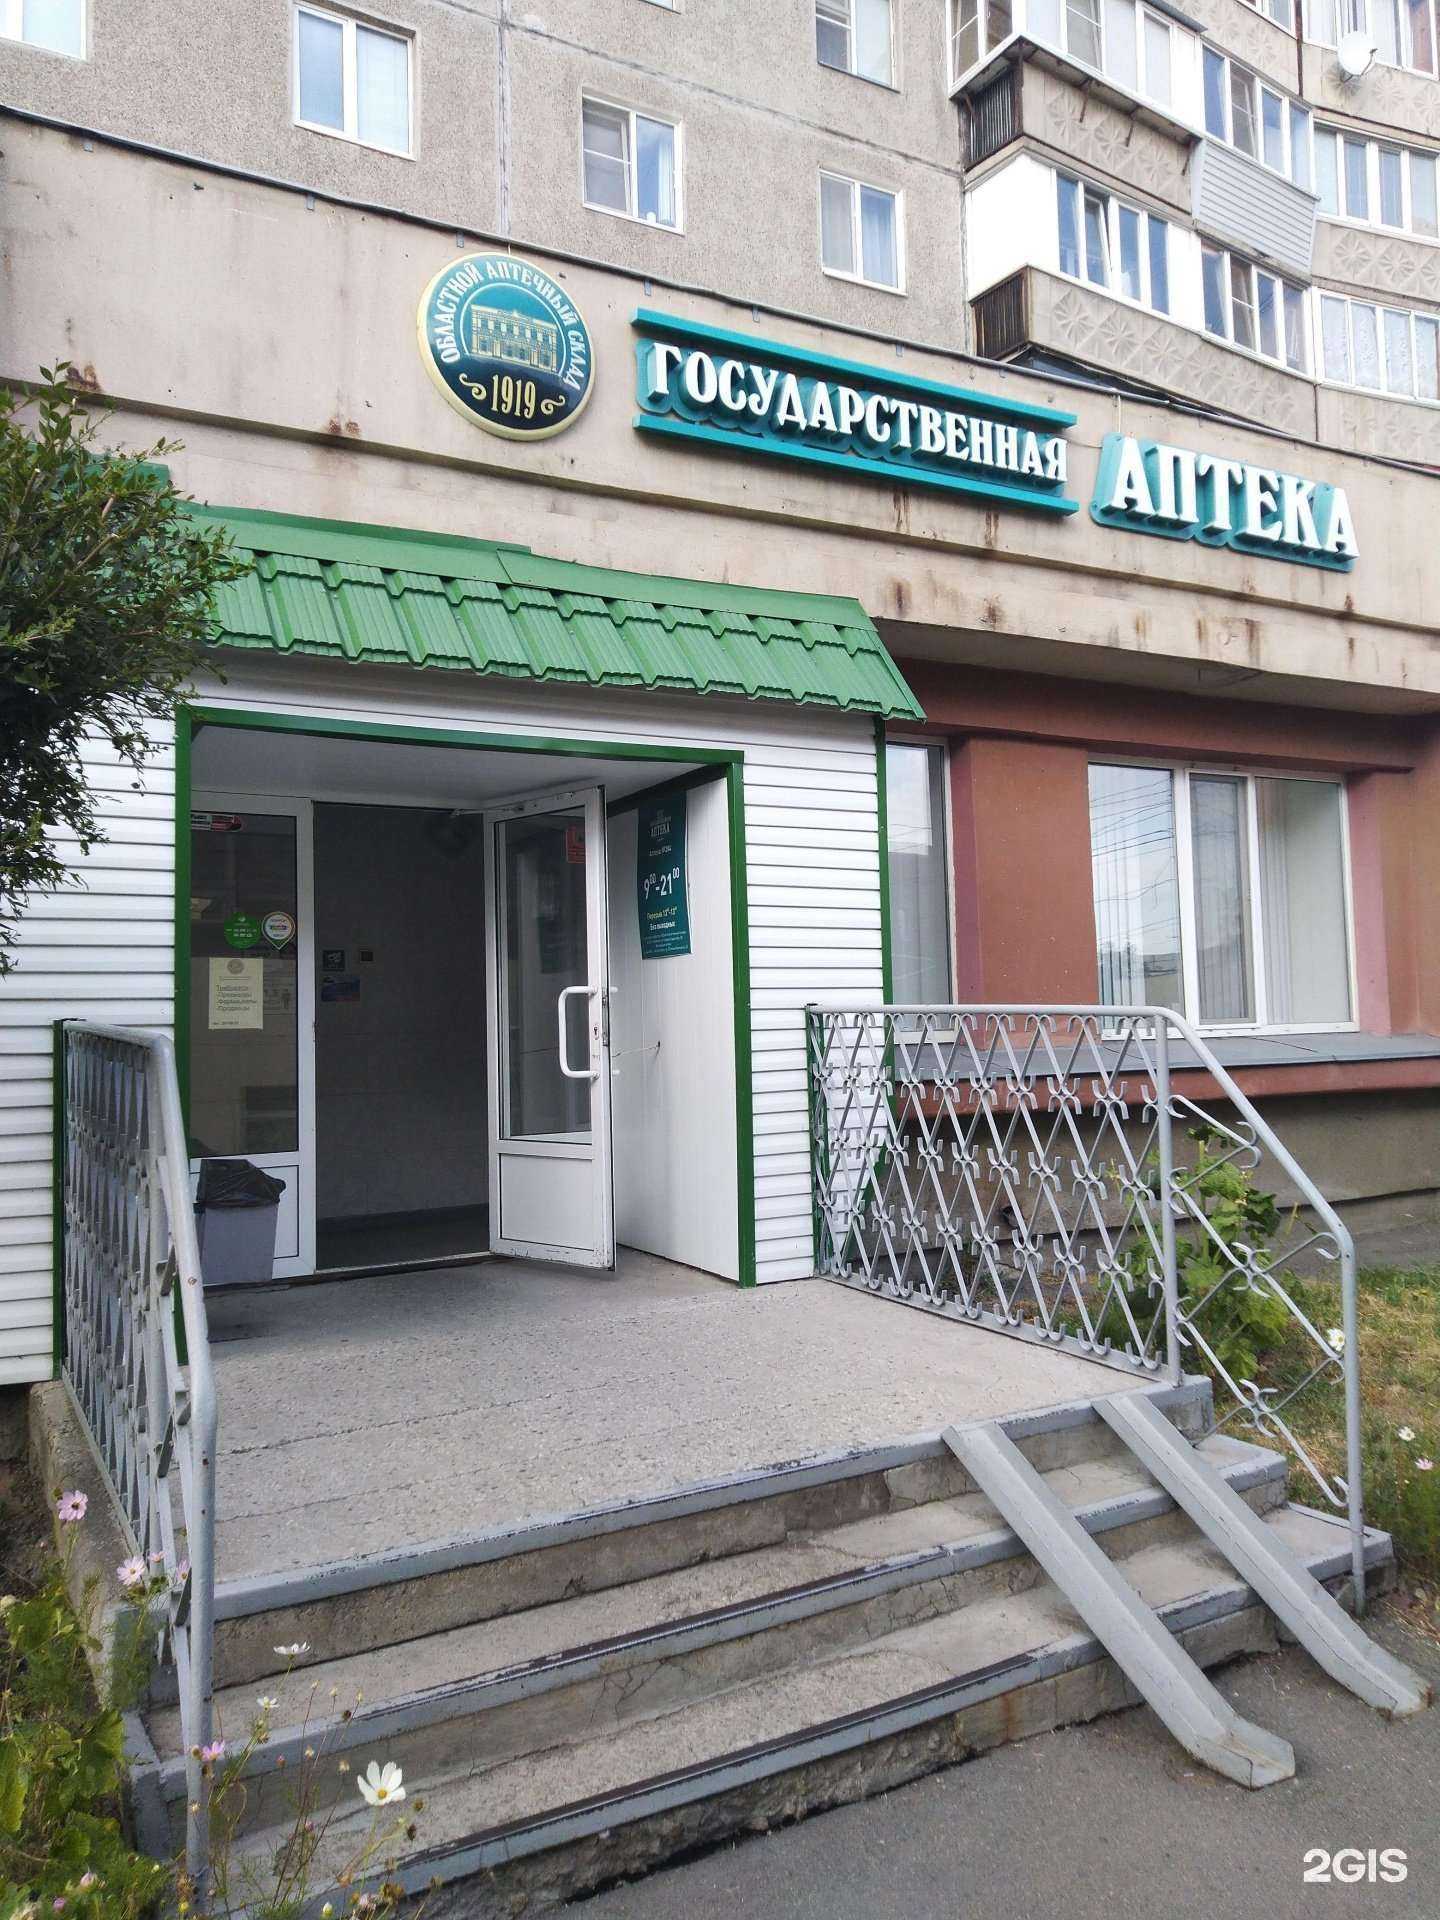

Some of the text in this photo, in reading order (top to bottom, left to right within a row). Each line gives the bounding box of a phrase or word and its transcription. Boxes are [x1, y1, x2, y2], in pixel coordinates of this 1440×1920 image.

[433, 261, 588, 391] ОБЛАСТНОЙ АПТЕЧНЫЙ СКЛАД
[490, 373, 537, 419] 1919
[648, 341, 1360, 559] ГОСУДАРСТВЕННАЯ АПТЕКА
